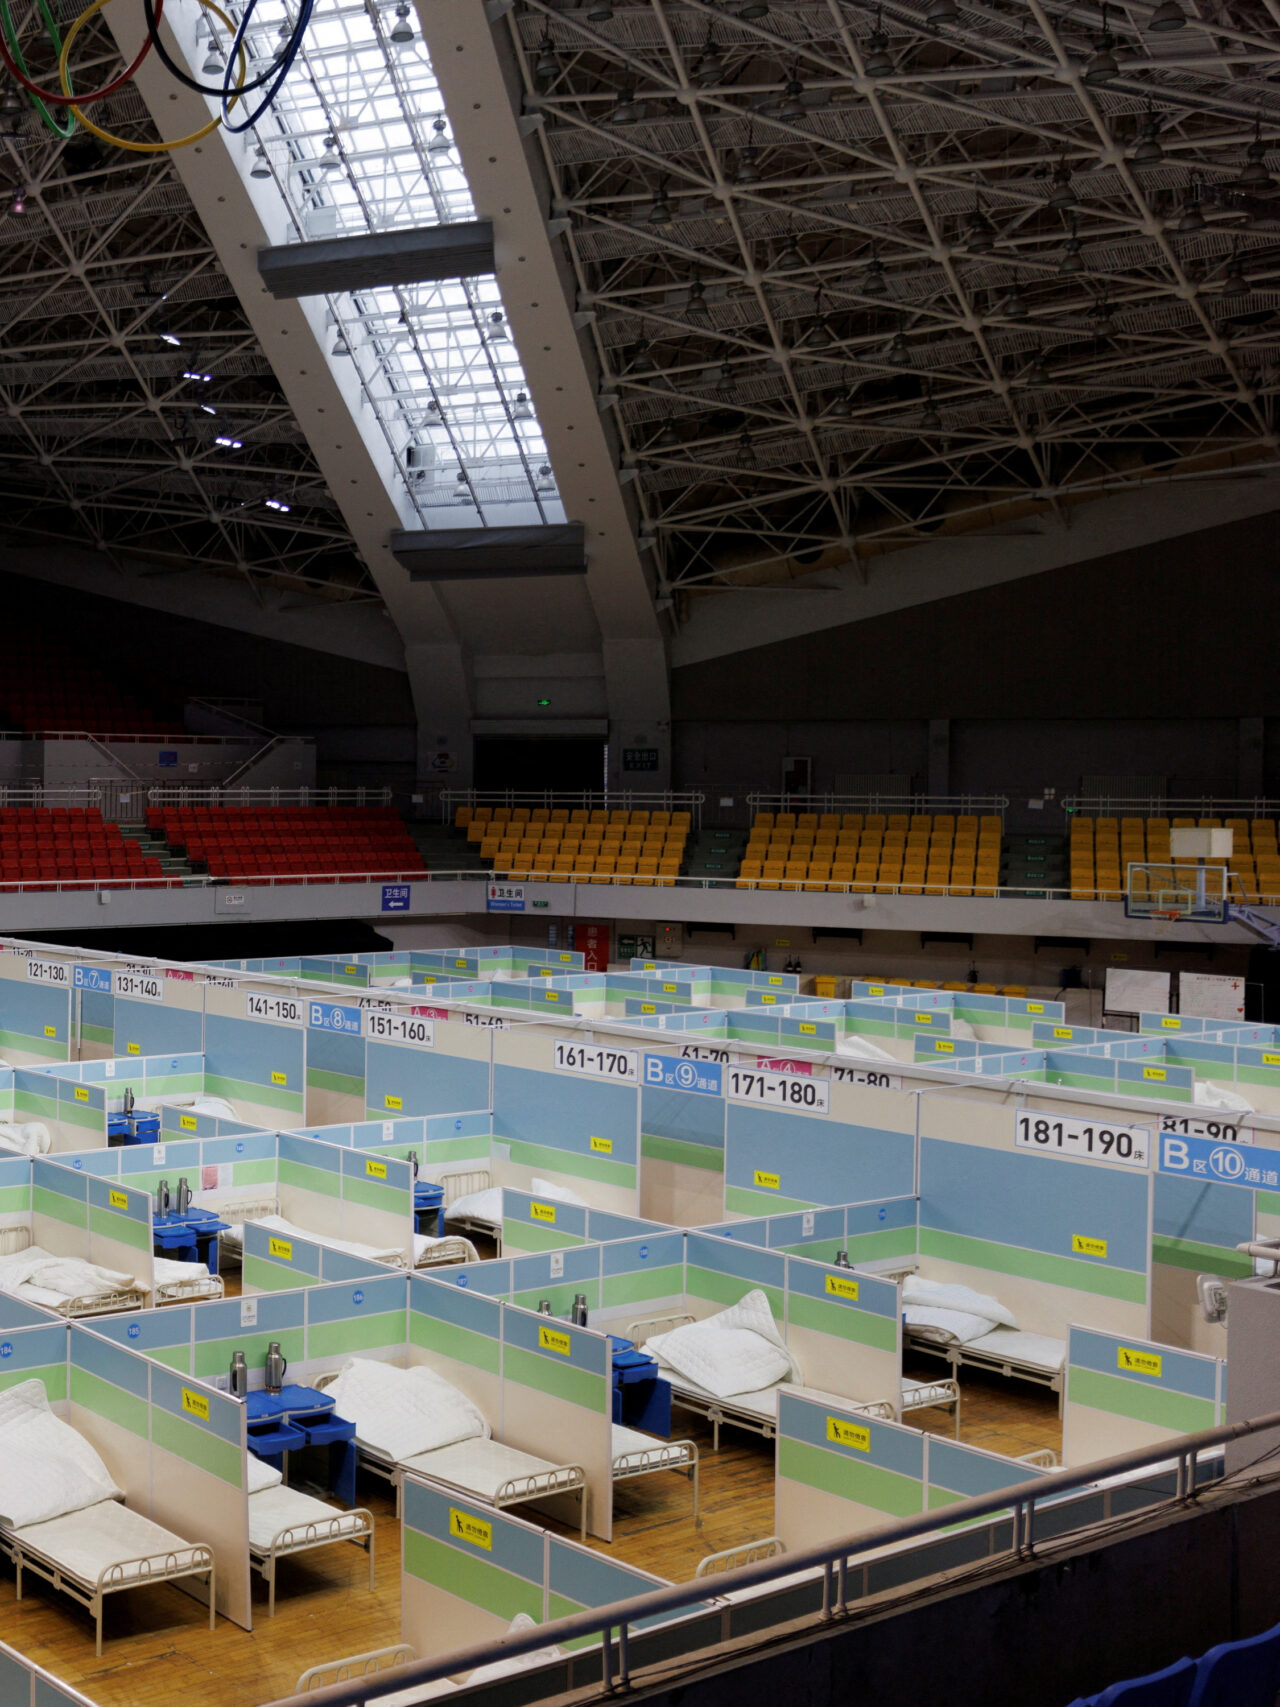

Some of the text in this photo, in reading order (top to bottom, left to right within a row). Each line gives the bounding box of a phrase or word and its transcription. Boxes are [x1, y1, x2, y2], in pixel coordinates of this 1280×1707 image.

[385, 888, 408, 899] 卫生间
[498, 888, 523, 898] 卫生间
[0, 1345, 12, 1354] 184
